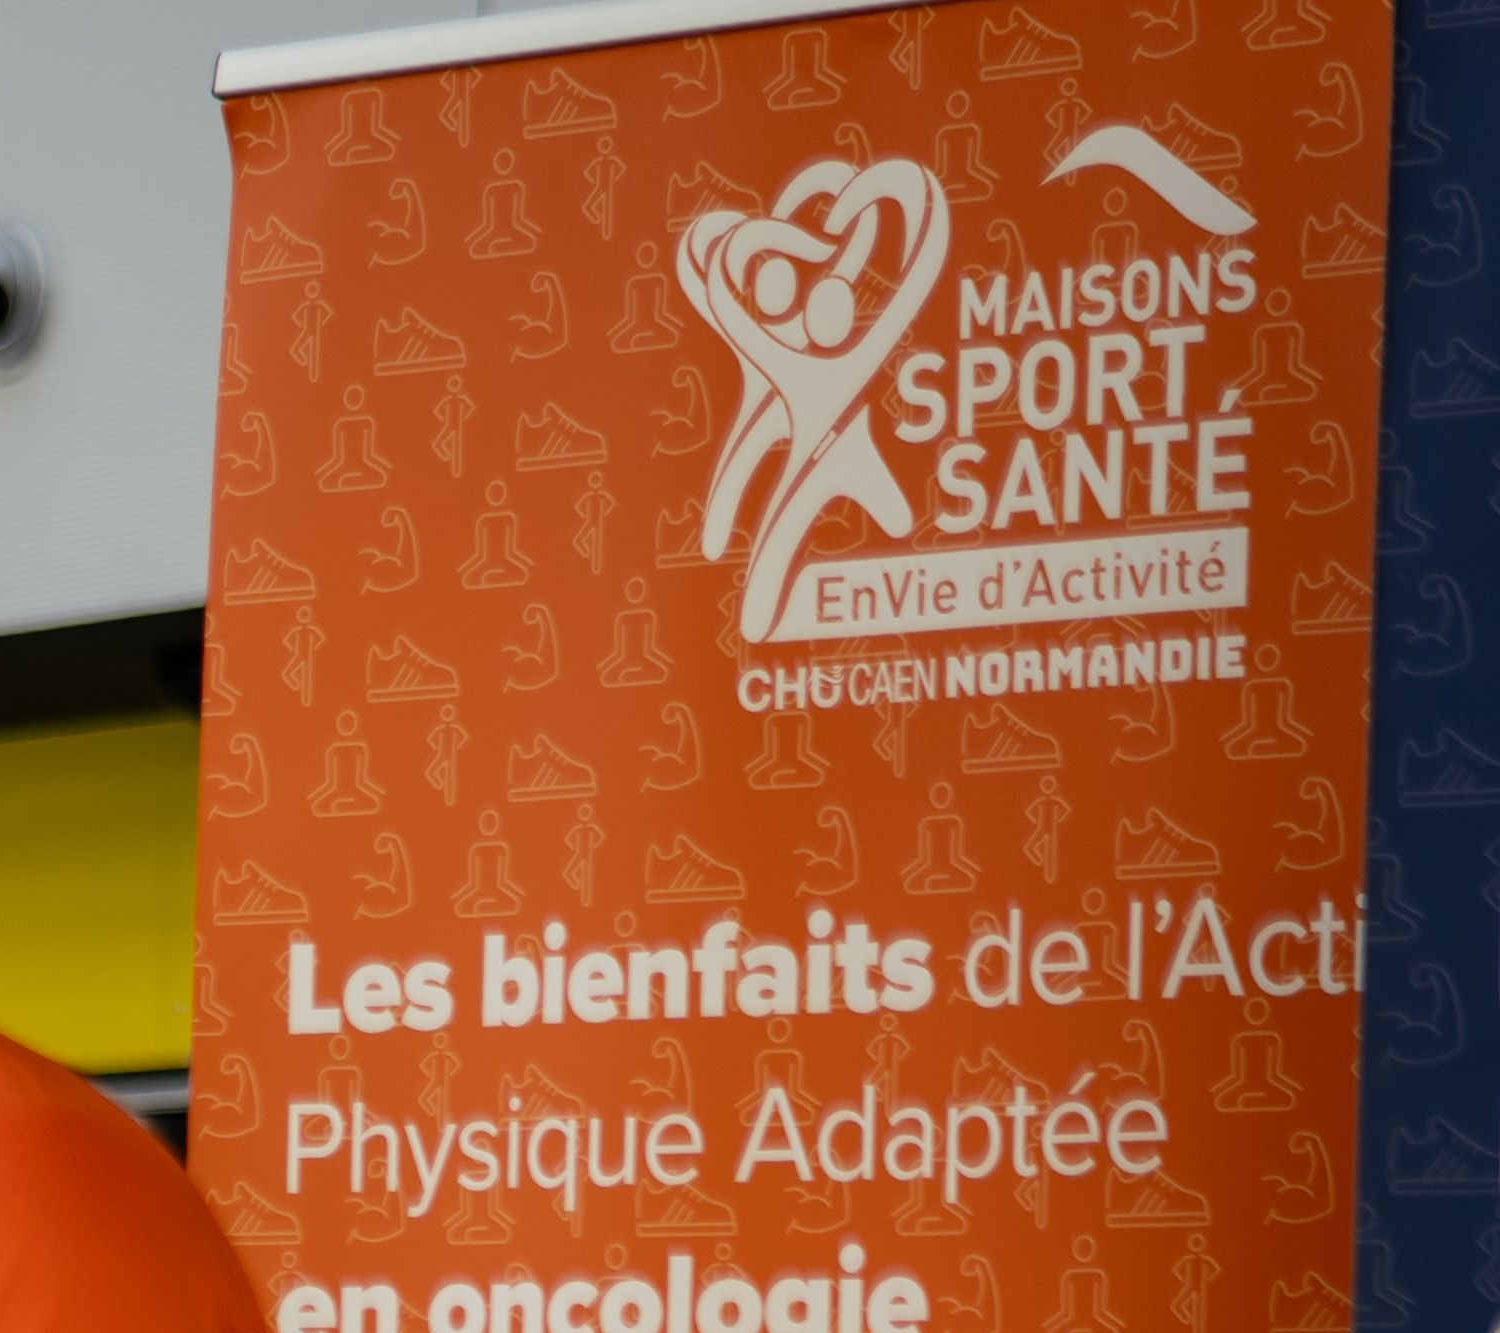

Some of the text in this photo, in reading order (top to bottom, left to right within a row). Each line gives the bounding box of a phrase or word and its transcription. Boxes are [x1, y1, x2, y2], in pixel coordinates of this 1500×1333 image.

[959, 248, 1256, 340] MAISONS
[895, 326, 1205, 443] SPORT
[936, 392, 1252, 534] SANTÉ
[814, 539, 1227, 627] EnVie d'Activité
[737, 636, 1246, 713] CHU CAEN NORMANDIE
[287, 943, 453, 1036] Les
[482, 909, 936, 1027] bienfaits
[964, 907, 1089, 1006] de
[285, 1071, 1169, 1215] Physique Adaptée
